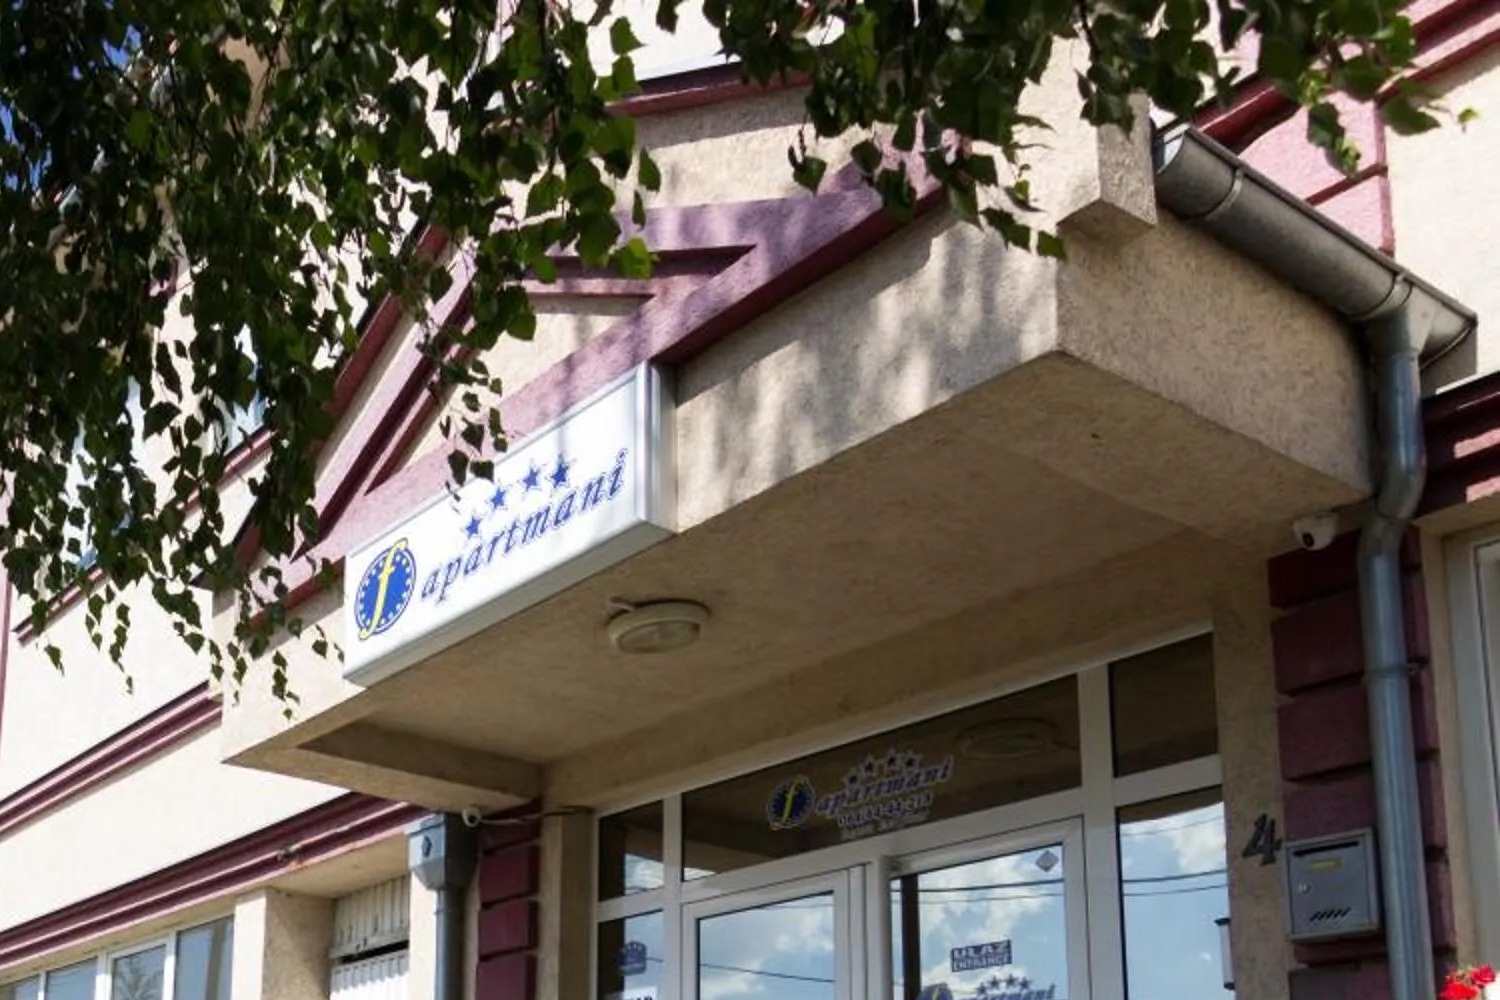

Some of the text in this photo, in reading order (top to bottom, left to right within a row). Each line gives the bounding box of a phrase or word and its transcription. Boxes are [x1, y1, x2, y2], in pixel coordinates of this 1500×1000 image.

[420, 447, 629, 603] apartmani
[815, 755, 956, 817] apartmani
[1242, 813, 1282, 867] 4
[953, 941, 1008, 958] ULAZ
[953, 954, 1009, 971] ENTRANCE
